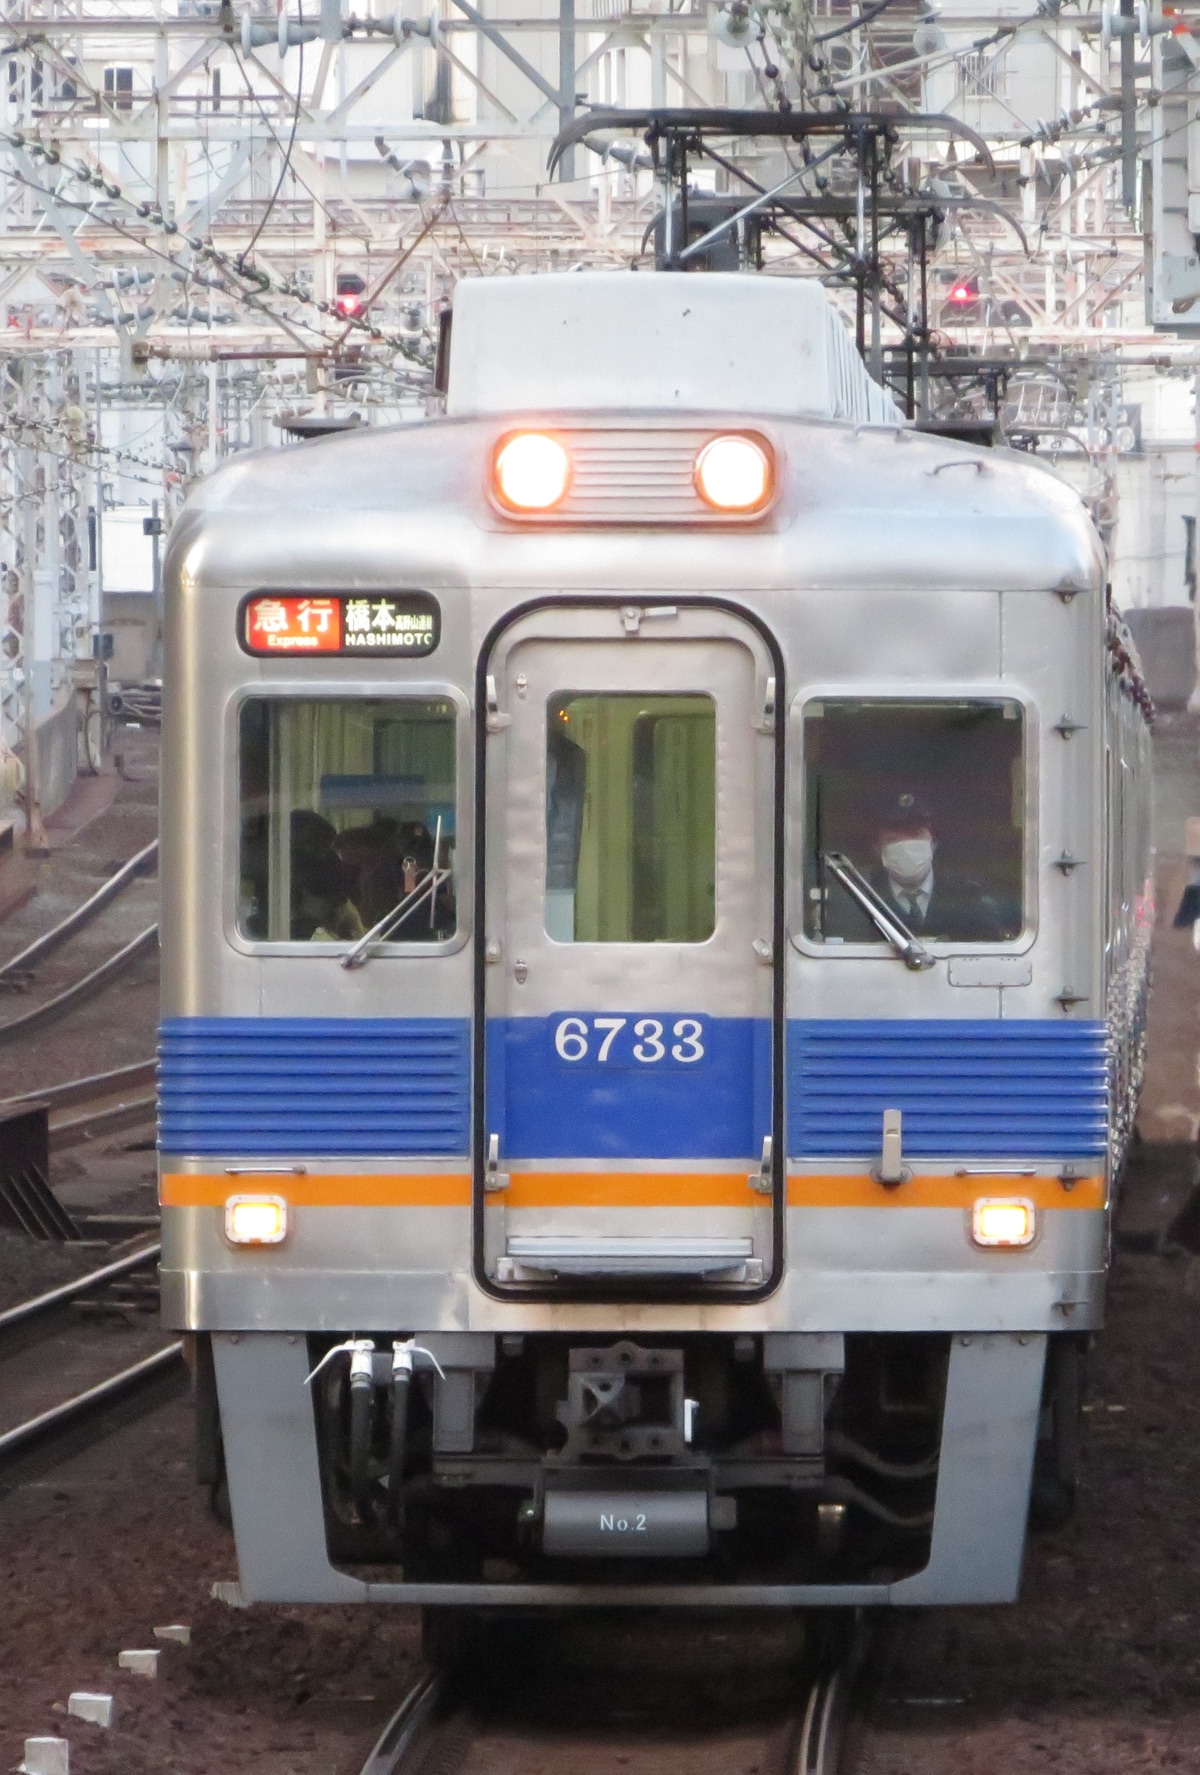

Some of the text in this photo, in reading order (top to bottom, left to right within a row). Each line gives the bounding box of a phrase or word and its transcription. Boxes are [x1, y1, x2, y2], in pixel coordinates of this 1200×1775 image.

[253, 598, 333, 633] 急行
[345, 598, 396, 632] 橋本
[267, 634, 319, 649] Express
[554, 1017, 705, 1063] 6733
[599, 1513, 647, 1531] No.2
